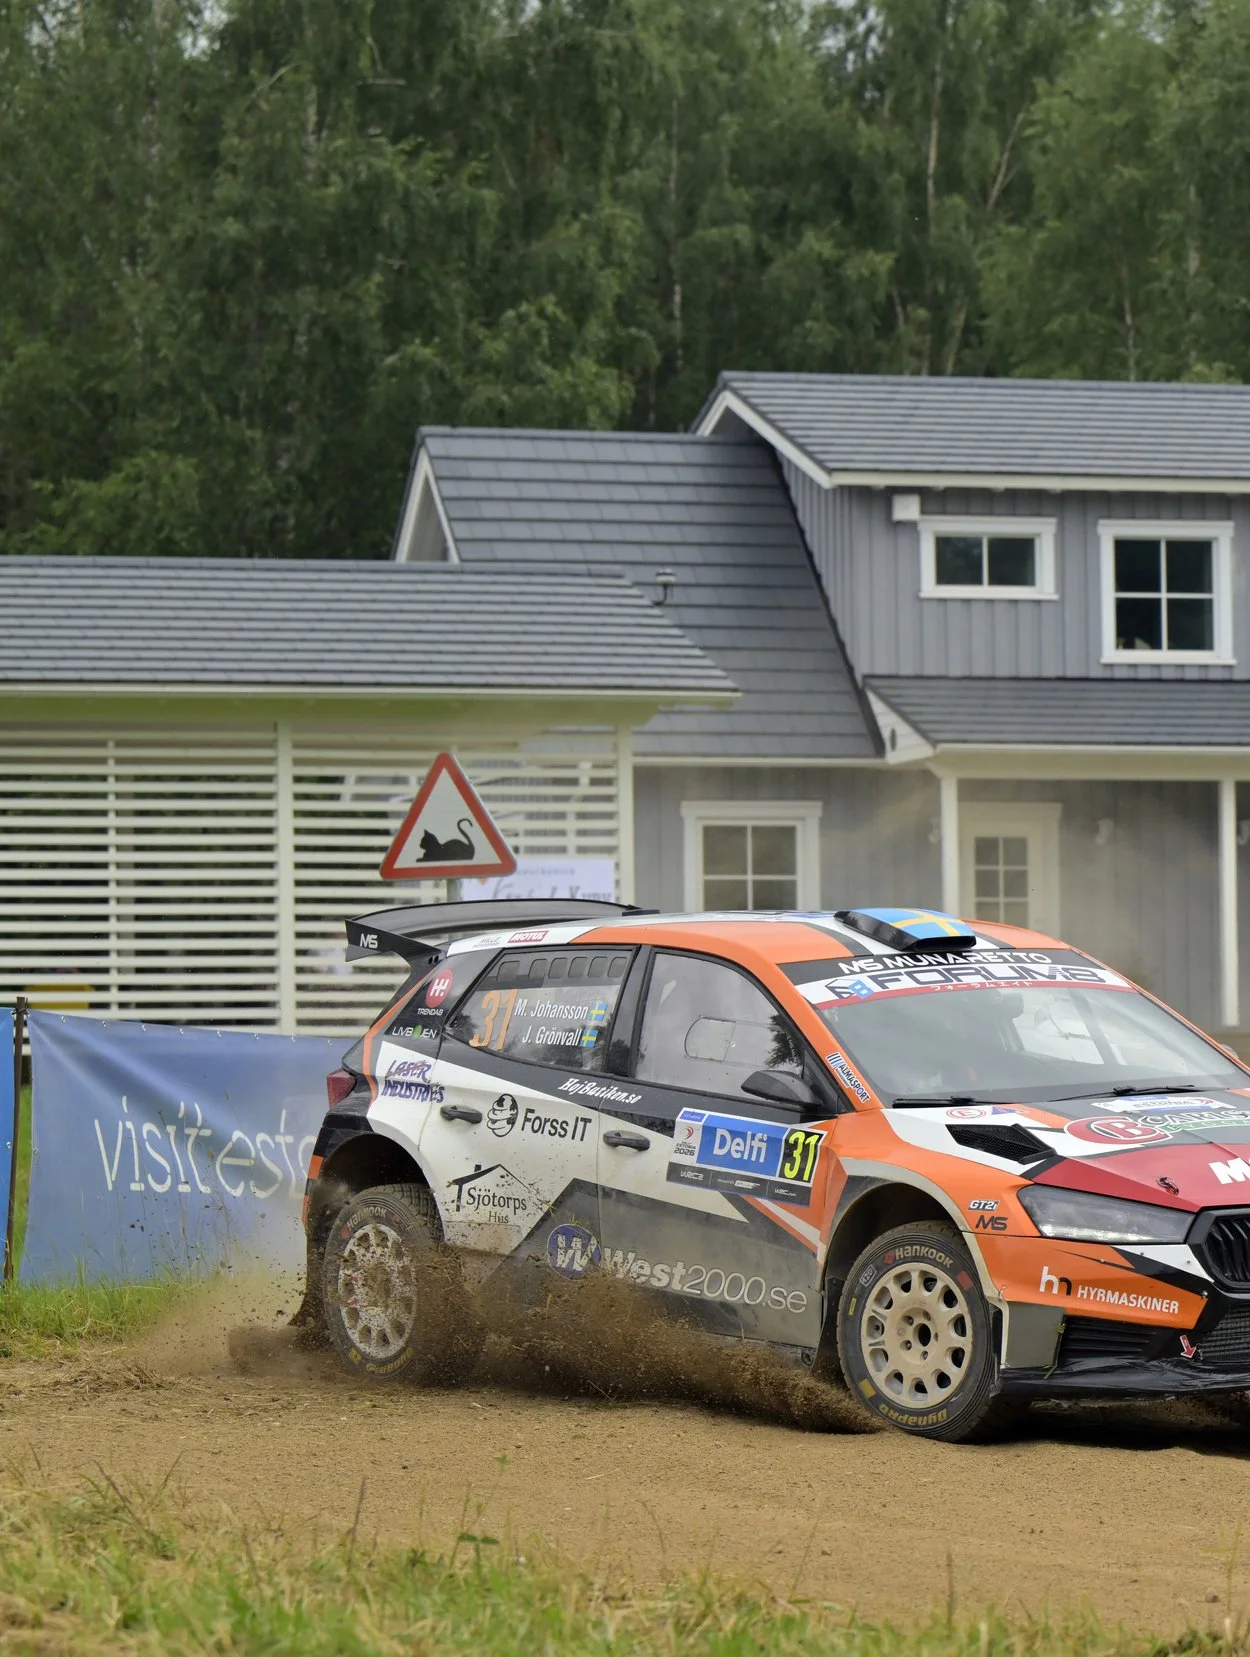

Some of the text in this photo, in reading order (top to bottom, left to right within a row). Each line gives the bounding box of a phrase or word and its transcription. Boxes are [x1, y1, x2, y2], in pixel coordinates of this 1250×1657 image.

[881, 951, 1053, 969] MUNARETTO
[866, 964, 1107, 990] FORUM8
[469, 988, 518, 1050] 31
[514, 999, 588, 1020] M. Johansson
[522, 1026, 582, 1047] J. Grönvall
[839, 1063, 870, 1102] ALMASPORT
[521, 1108, 592, 1142] Forss IT
[674, 1148, 696, 1157] 2026
[713, 1128, 768, 1163] Delfi
[784, 1131, 820, 1182] 31
[466, 1187, 527, 1216] Sjötorps
[488, 1211, 510, 1224] Hus
[603, 1247, 808, 1313] West2000.se
[1077, 1285, 1180, 1315] HYRMASKINER
